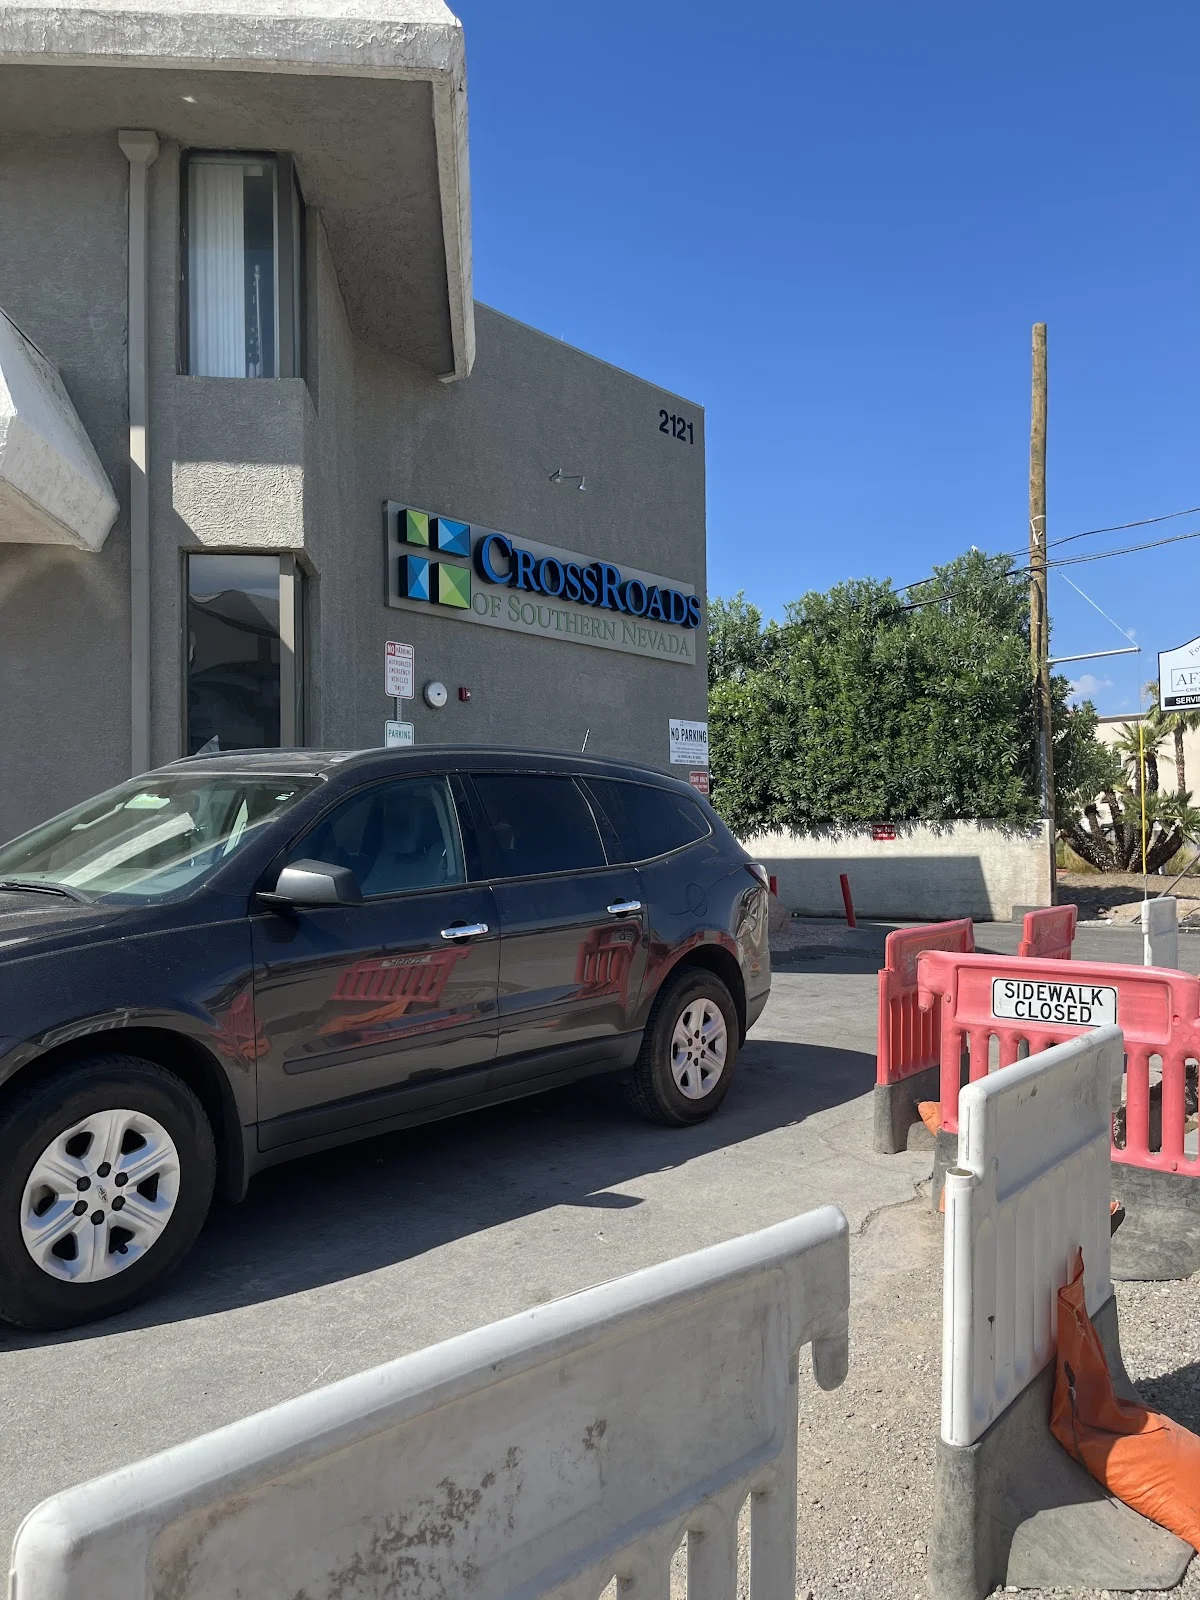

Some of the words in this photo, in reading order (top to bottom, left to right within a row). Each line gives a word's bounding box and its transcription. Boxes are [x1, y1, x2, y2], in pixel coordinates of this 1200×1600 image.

[659, 409, 694, 445] 2121
[472, 592, 502, 618] OF
[507, 595, 616, 641] SOUTHERN
[621, 620, 691, 657] NEVADA
[387, 644, 395, 654] NO
[396, 646, 412, 656] PARKING
[388, 667, 411, 676] EMERGENCY
[388, 728, 411, 740] PARKING
[671, 727, 680, 741] NO
[681, 728, 707, 743] PARKING
[1004, 981, 1104, 1007] SIDEWALK
[1014, 1000, 1092, 1024] CLOSED
